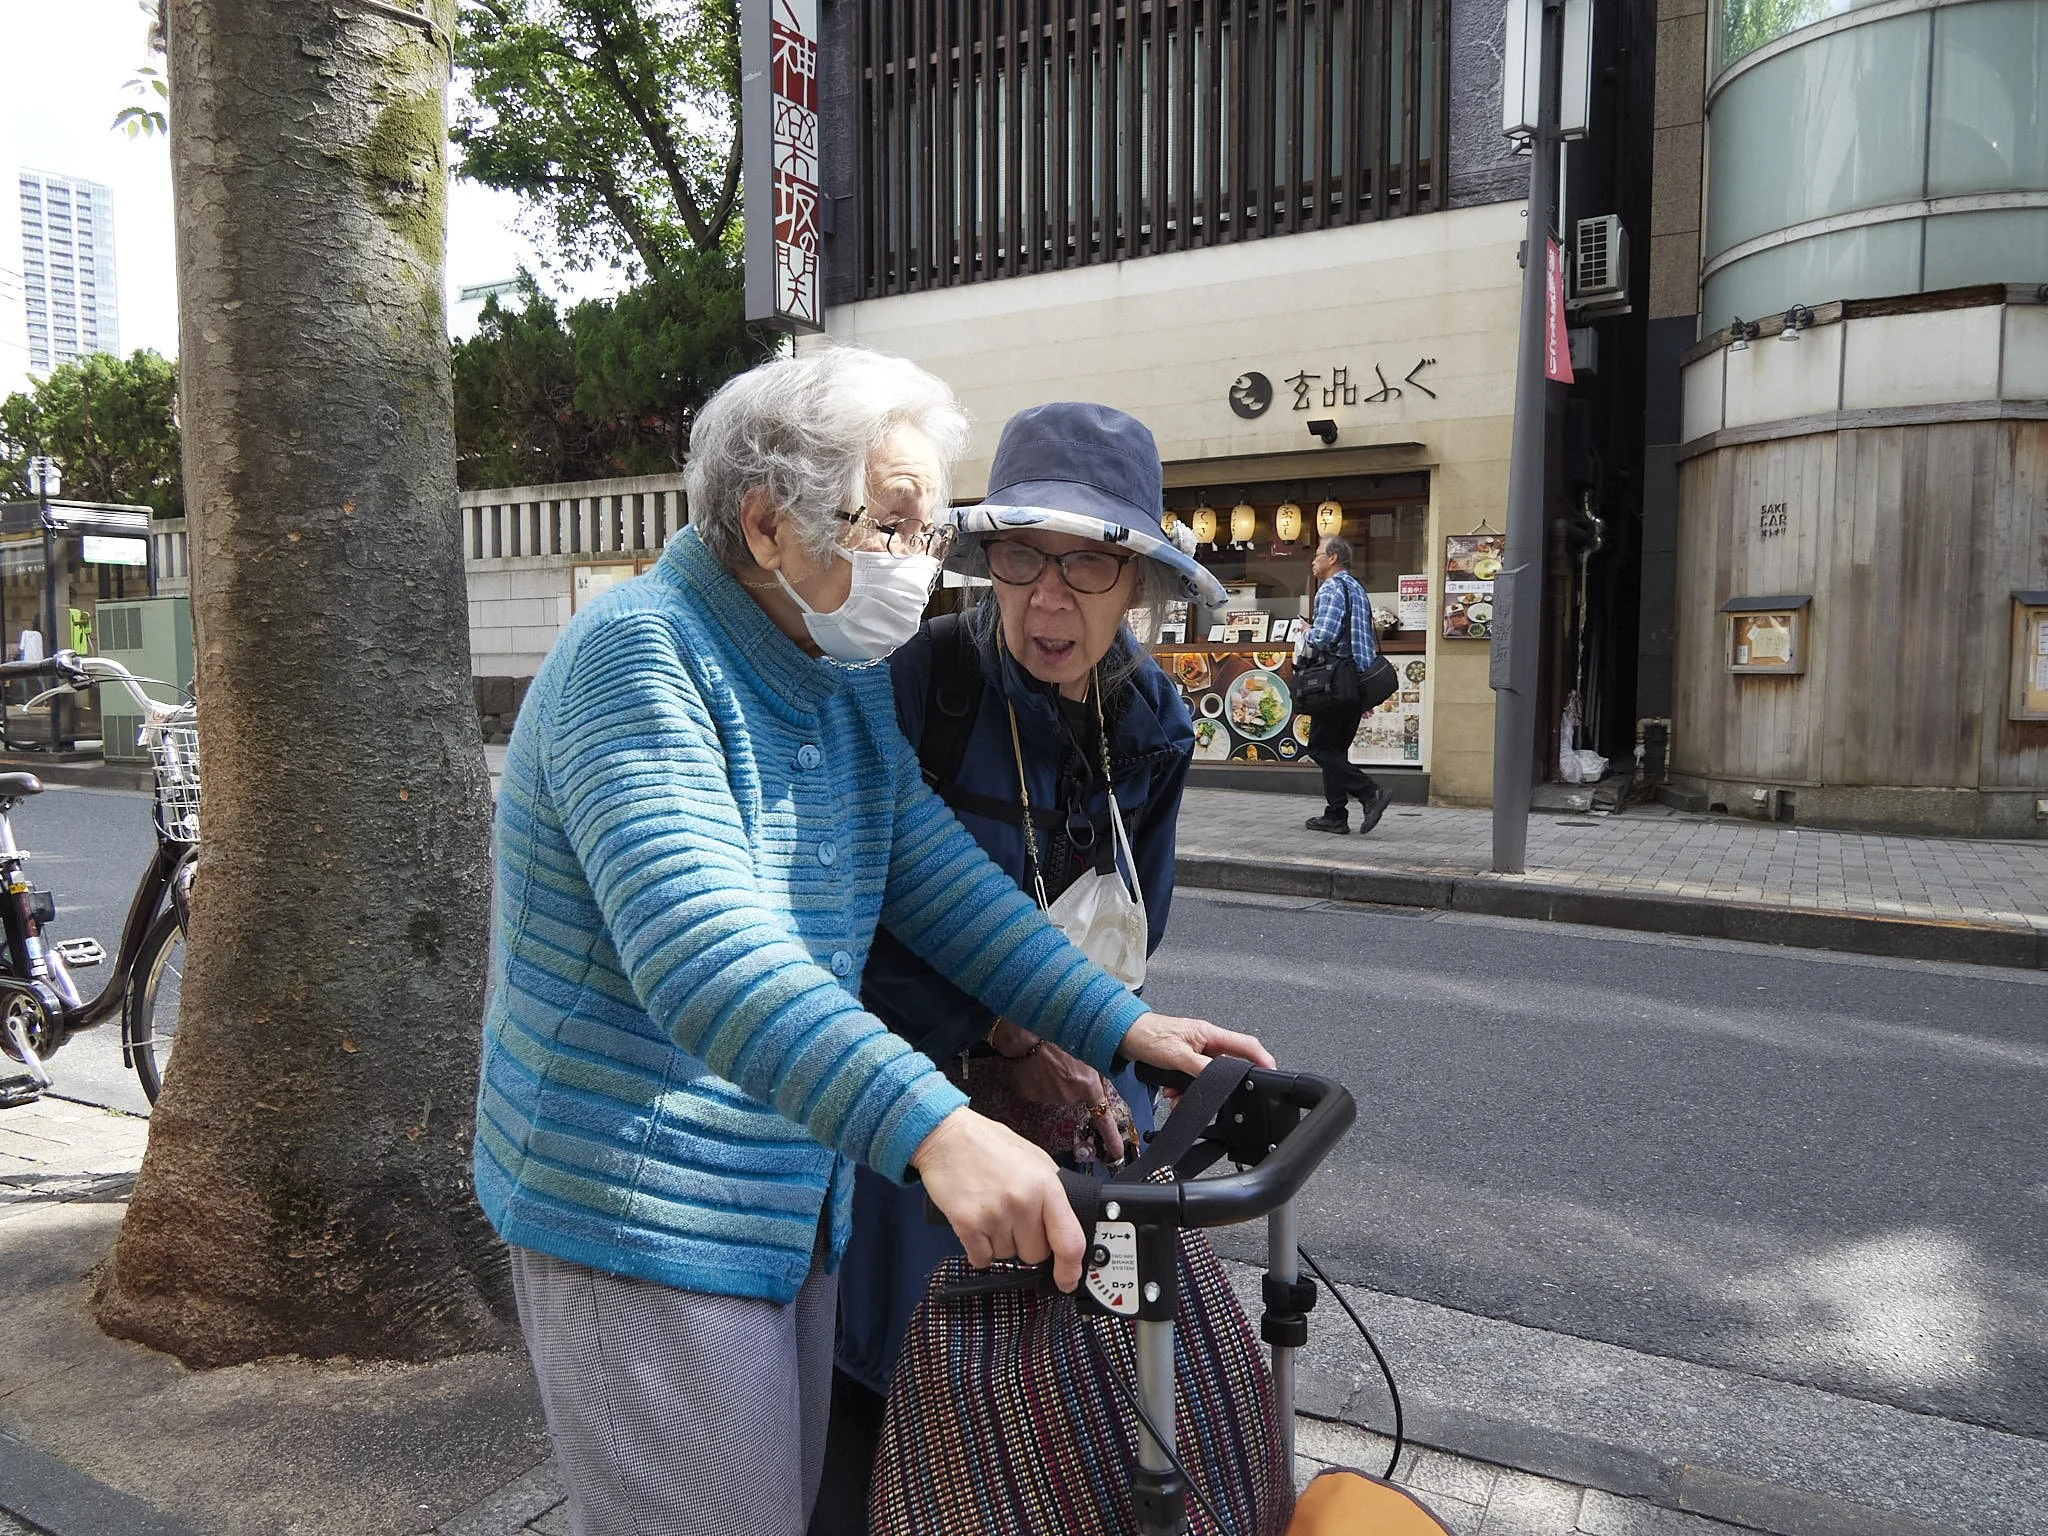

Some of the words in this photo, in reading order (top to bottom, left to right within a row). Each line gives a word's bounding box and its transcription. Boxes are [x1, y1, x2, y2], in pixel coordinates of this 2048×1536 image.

[1284, 357, 1437, 411] 玄品ふぐ
[1761, 503, 1787, 515] SAKE
[1112, 1281, 1134, 1289] ロック
